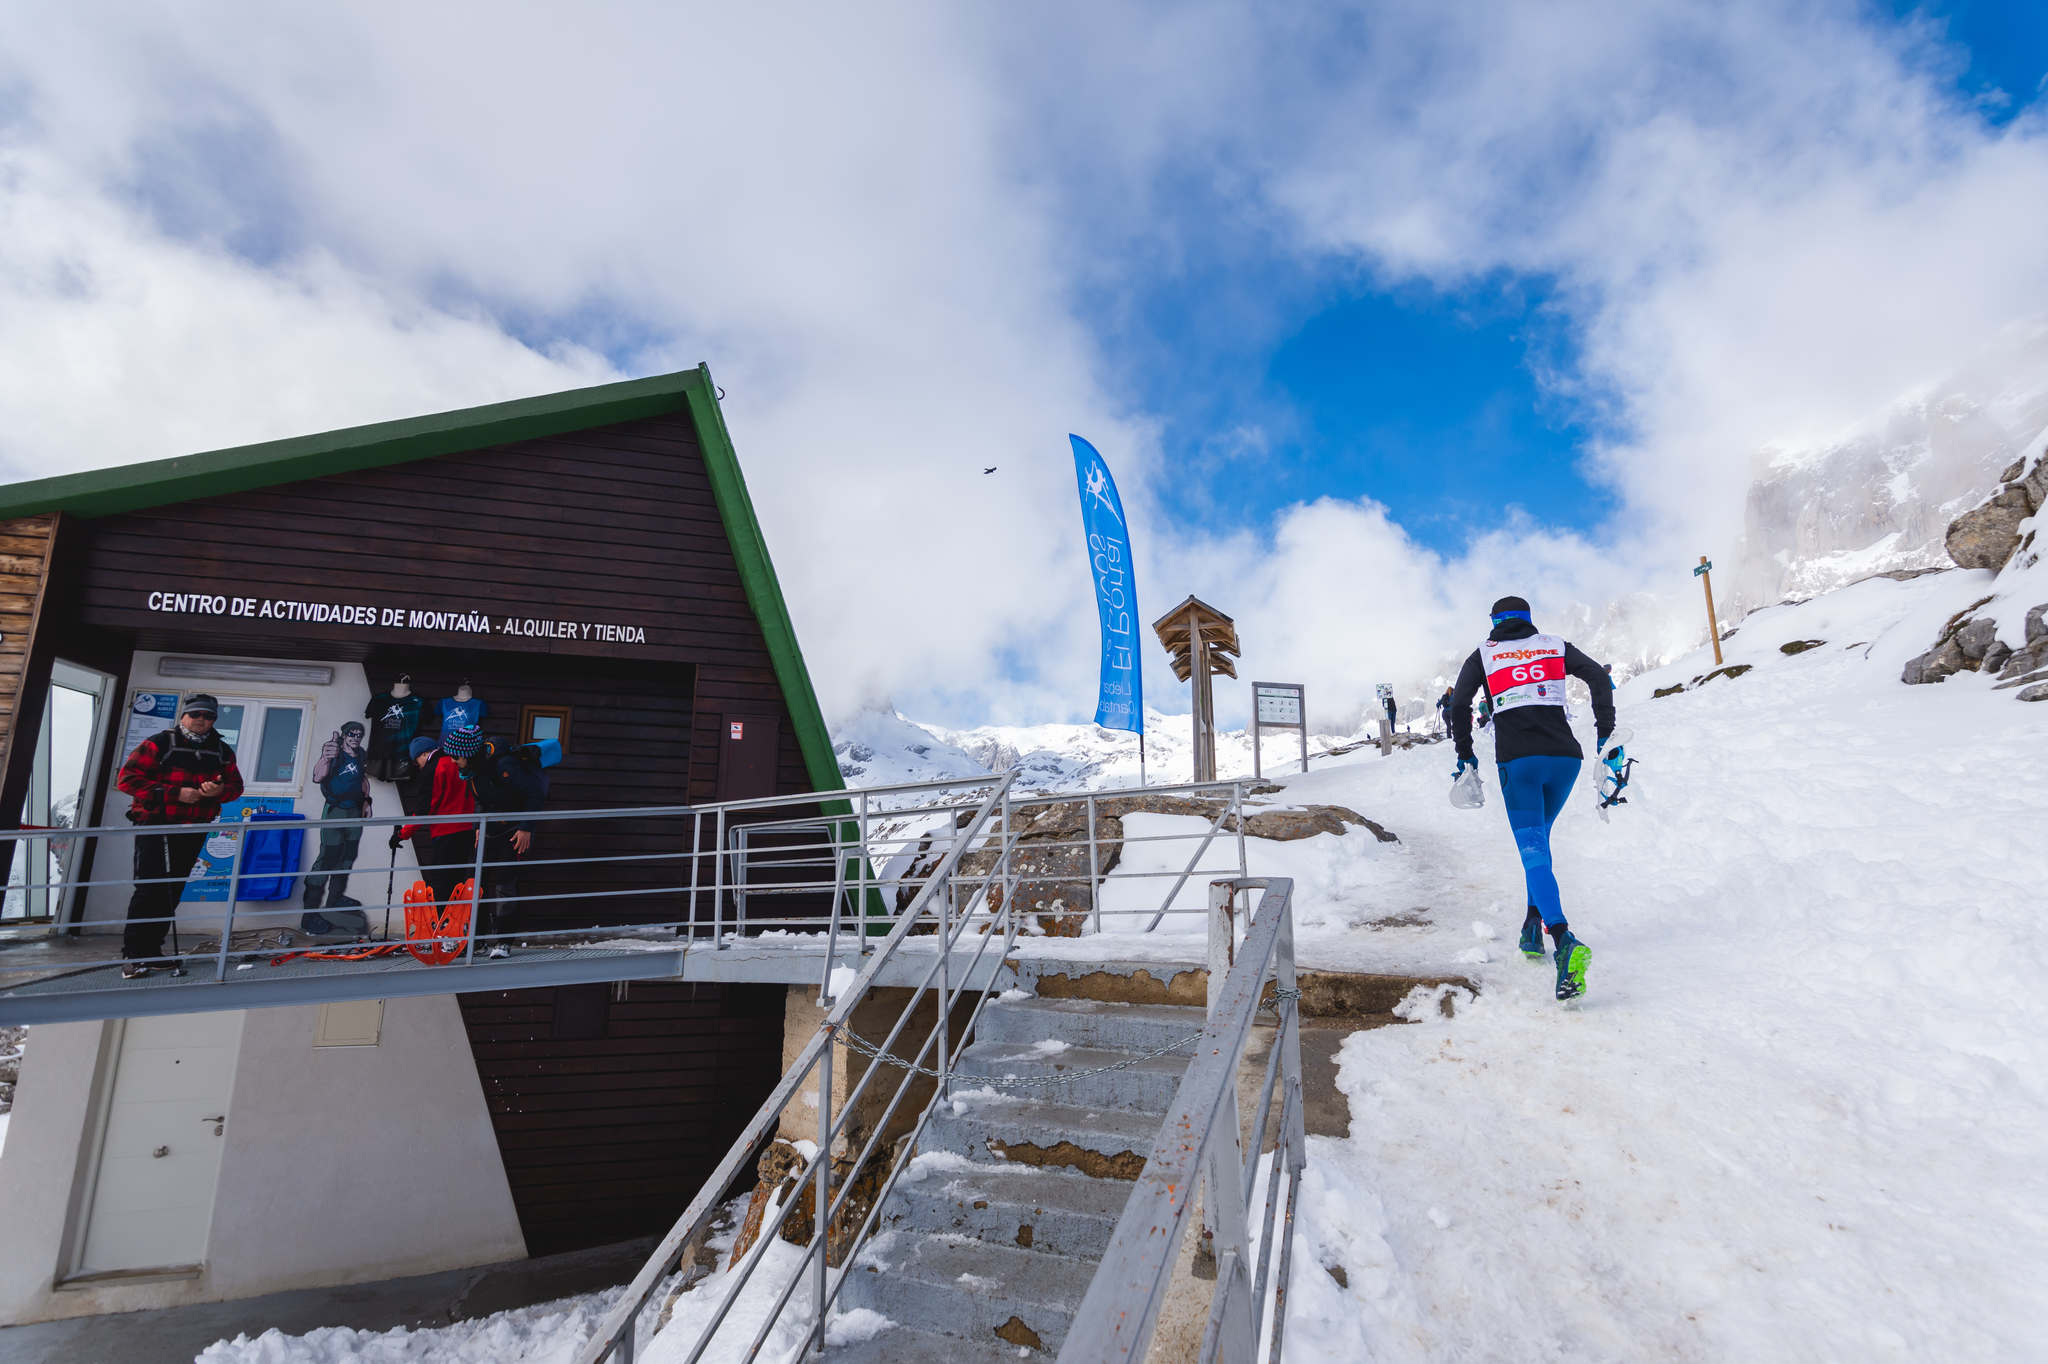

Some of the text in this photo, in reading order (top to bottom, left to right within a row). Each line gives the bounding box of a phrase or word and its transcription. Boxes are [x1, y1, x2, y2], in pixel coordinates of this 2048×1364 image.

[148, 591, 226, 615] CENTRO
[230, 598, 257, 617] DE
[259, 600, 377, 626] ACTIVIDADES
[381, 608, 405, 628] DE
[408, 610, 490, 634] MONTAÑA
[503, 618, 577, 639] ALQUILER
[580, 623, 592, 640] Y
[594, 624, 646, 644] TIENDA
[1512, 665, 1545, 681] 66
